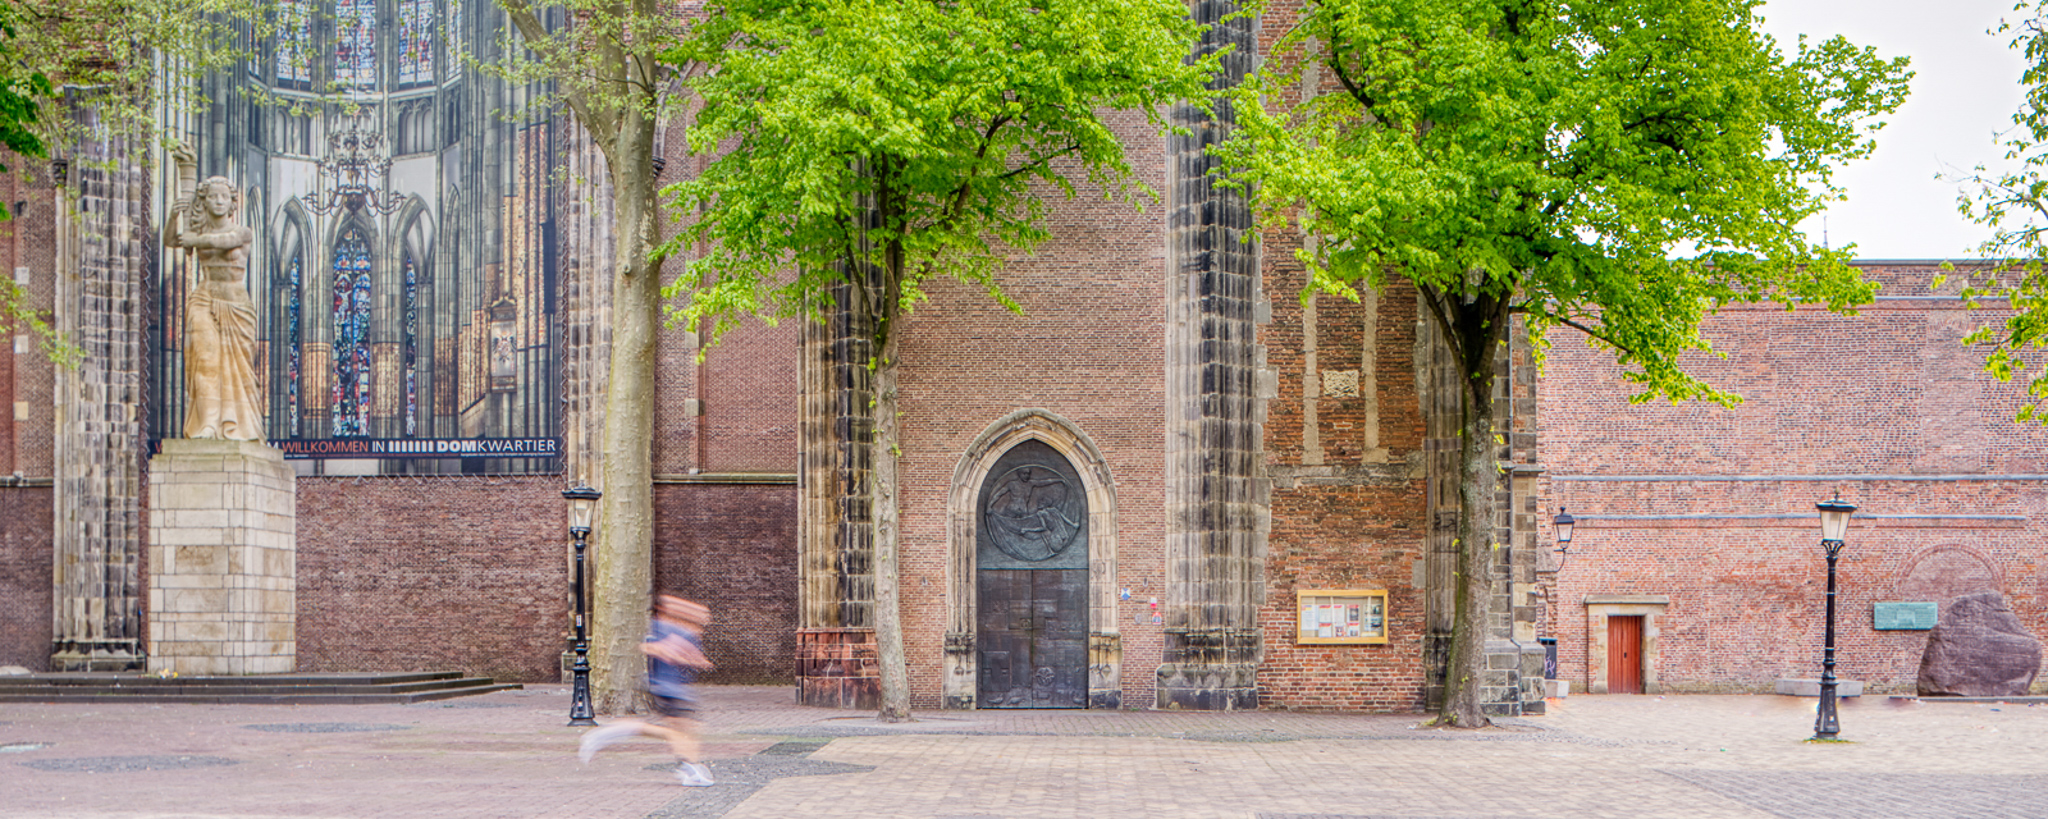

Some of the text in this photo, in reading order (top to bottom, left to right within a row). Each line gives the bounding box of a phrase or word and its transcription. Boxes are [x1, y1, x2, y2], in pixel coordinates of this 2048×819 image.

[282, 441, 368, 453] WILLKOMMEN
[372, 441, 385, 453] IN
[437, 440, 556, 453] DOMKWARTIER
